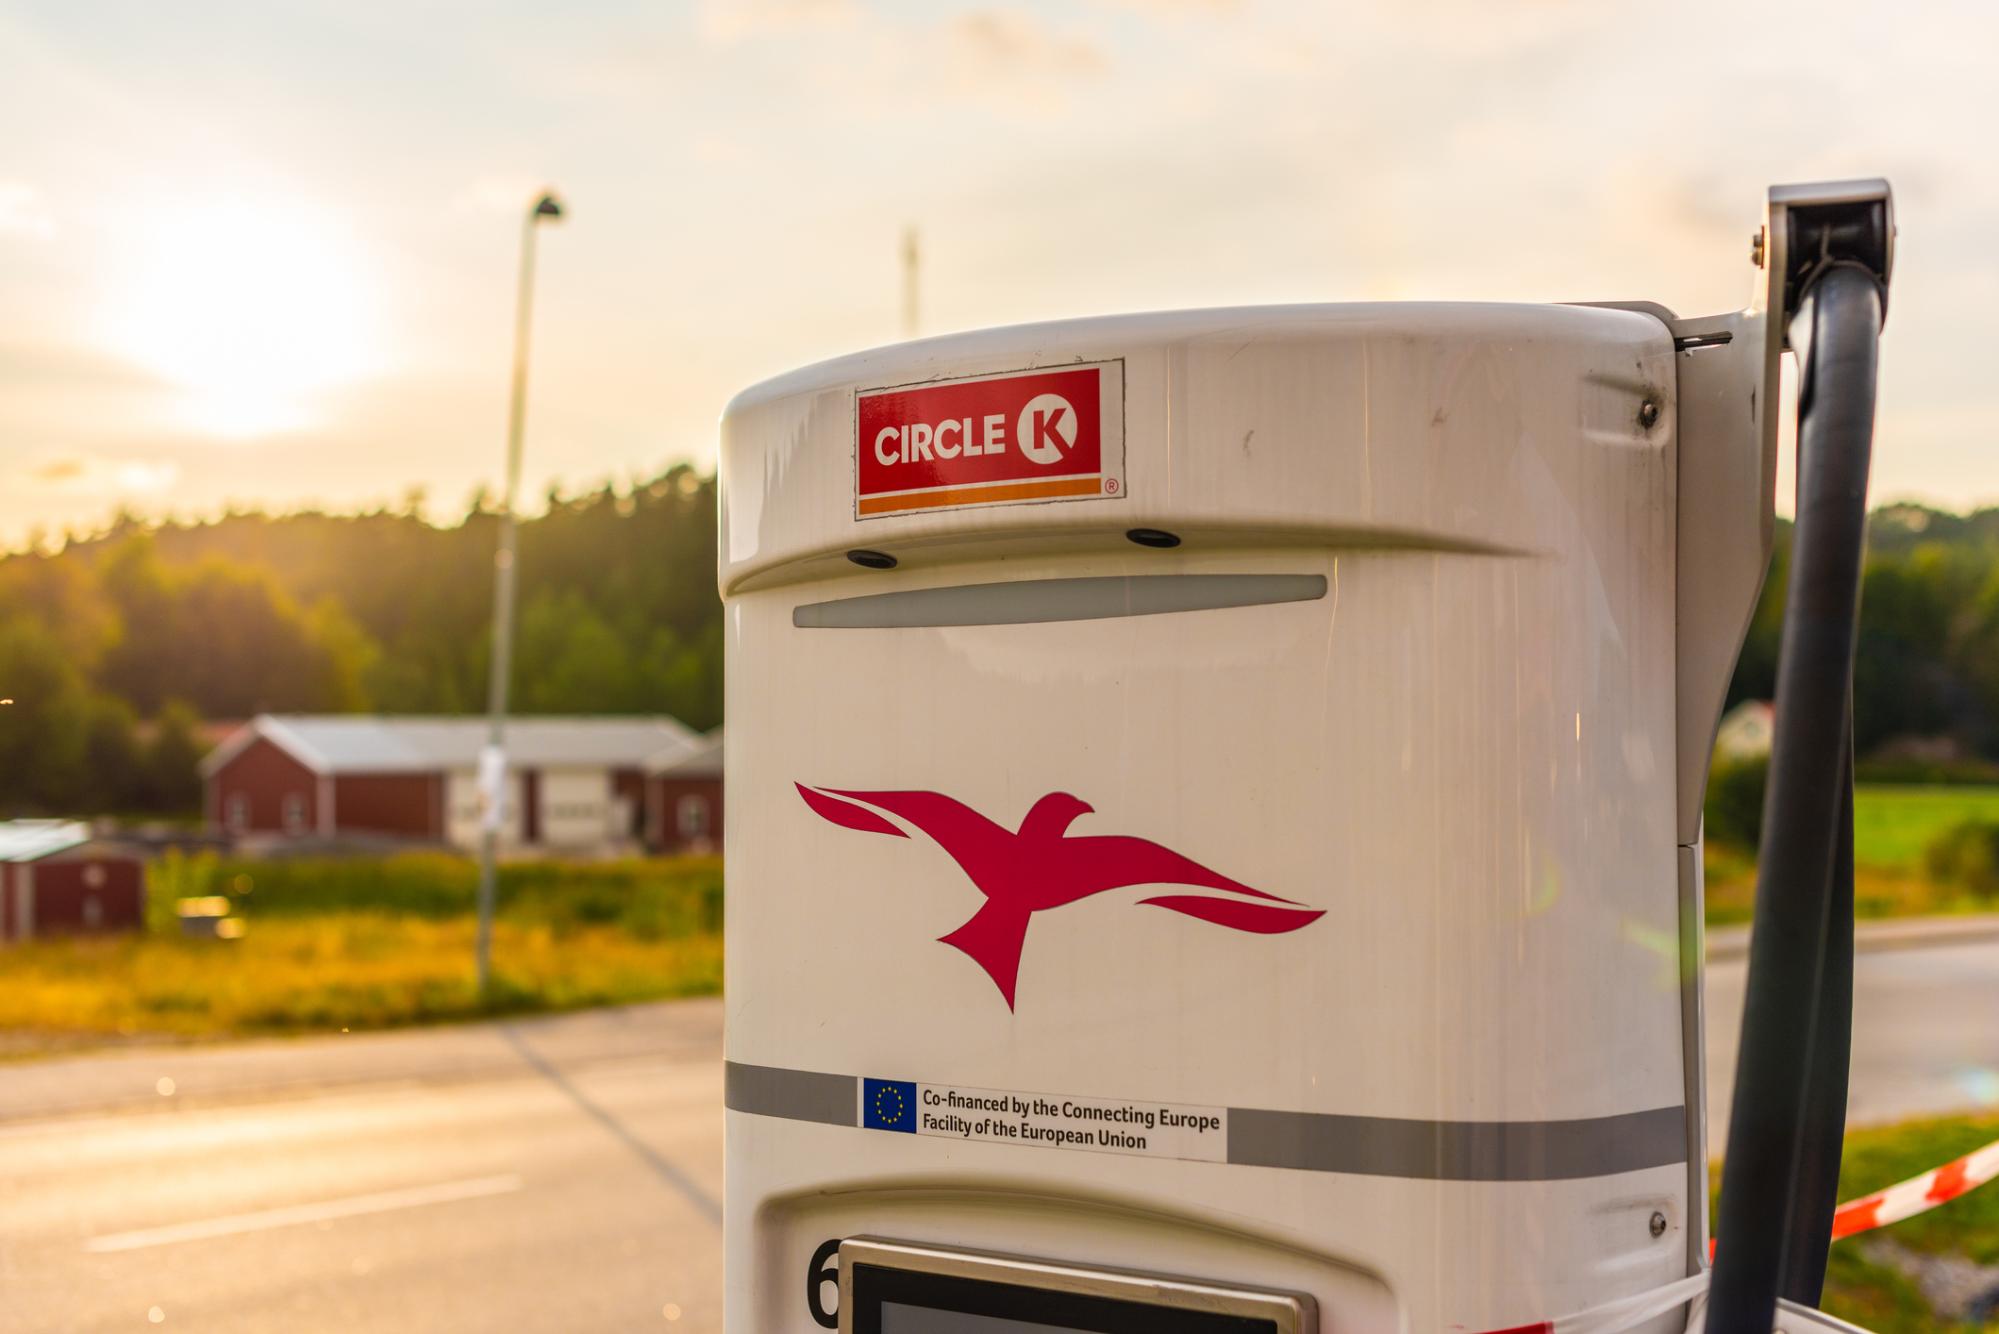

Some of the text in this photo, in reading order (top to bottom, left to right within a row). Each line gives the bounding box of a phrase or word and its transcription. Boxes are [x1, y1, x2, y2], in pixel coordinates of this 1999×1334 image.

[874, 406, 1075, 467] CIRCLE K
[923, 1089, 1221, 1134] Co-financed by the Connecting Europe
[923, 1113, 1147, 1150] Facility of the European Union
[807, 1238, 842, 1330] 6
